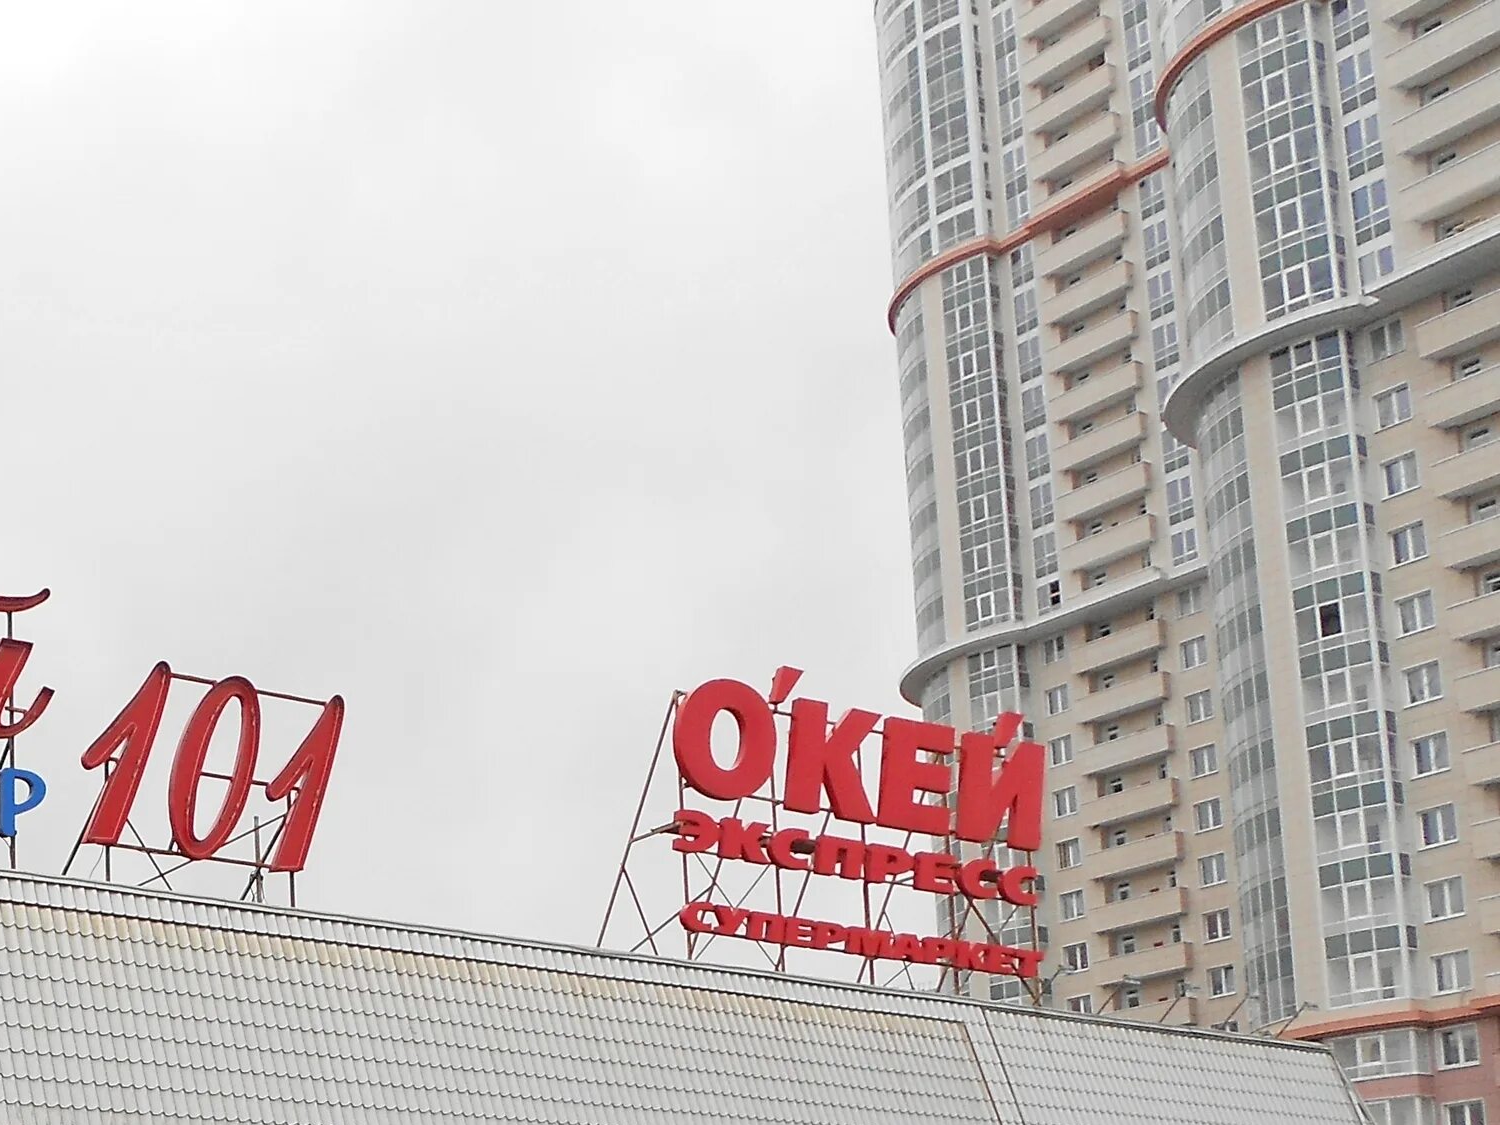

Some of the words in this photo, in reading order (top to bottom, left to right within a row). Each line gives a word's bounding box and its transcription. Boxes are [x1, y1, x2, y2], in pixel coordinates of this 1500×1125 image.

[80, 661, 344, 873] 101
[672, 809, 1038, 907] ЭКСПРЕСС
[679, 902, 1045, 978] СУПЕРМАРКЕТ
